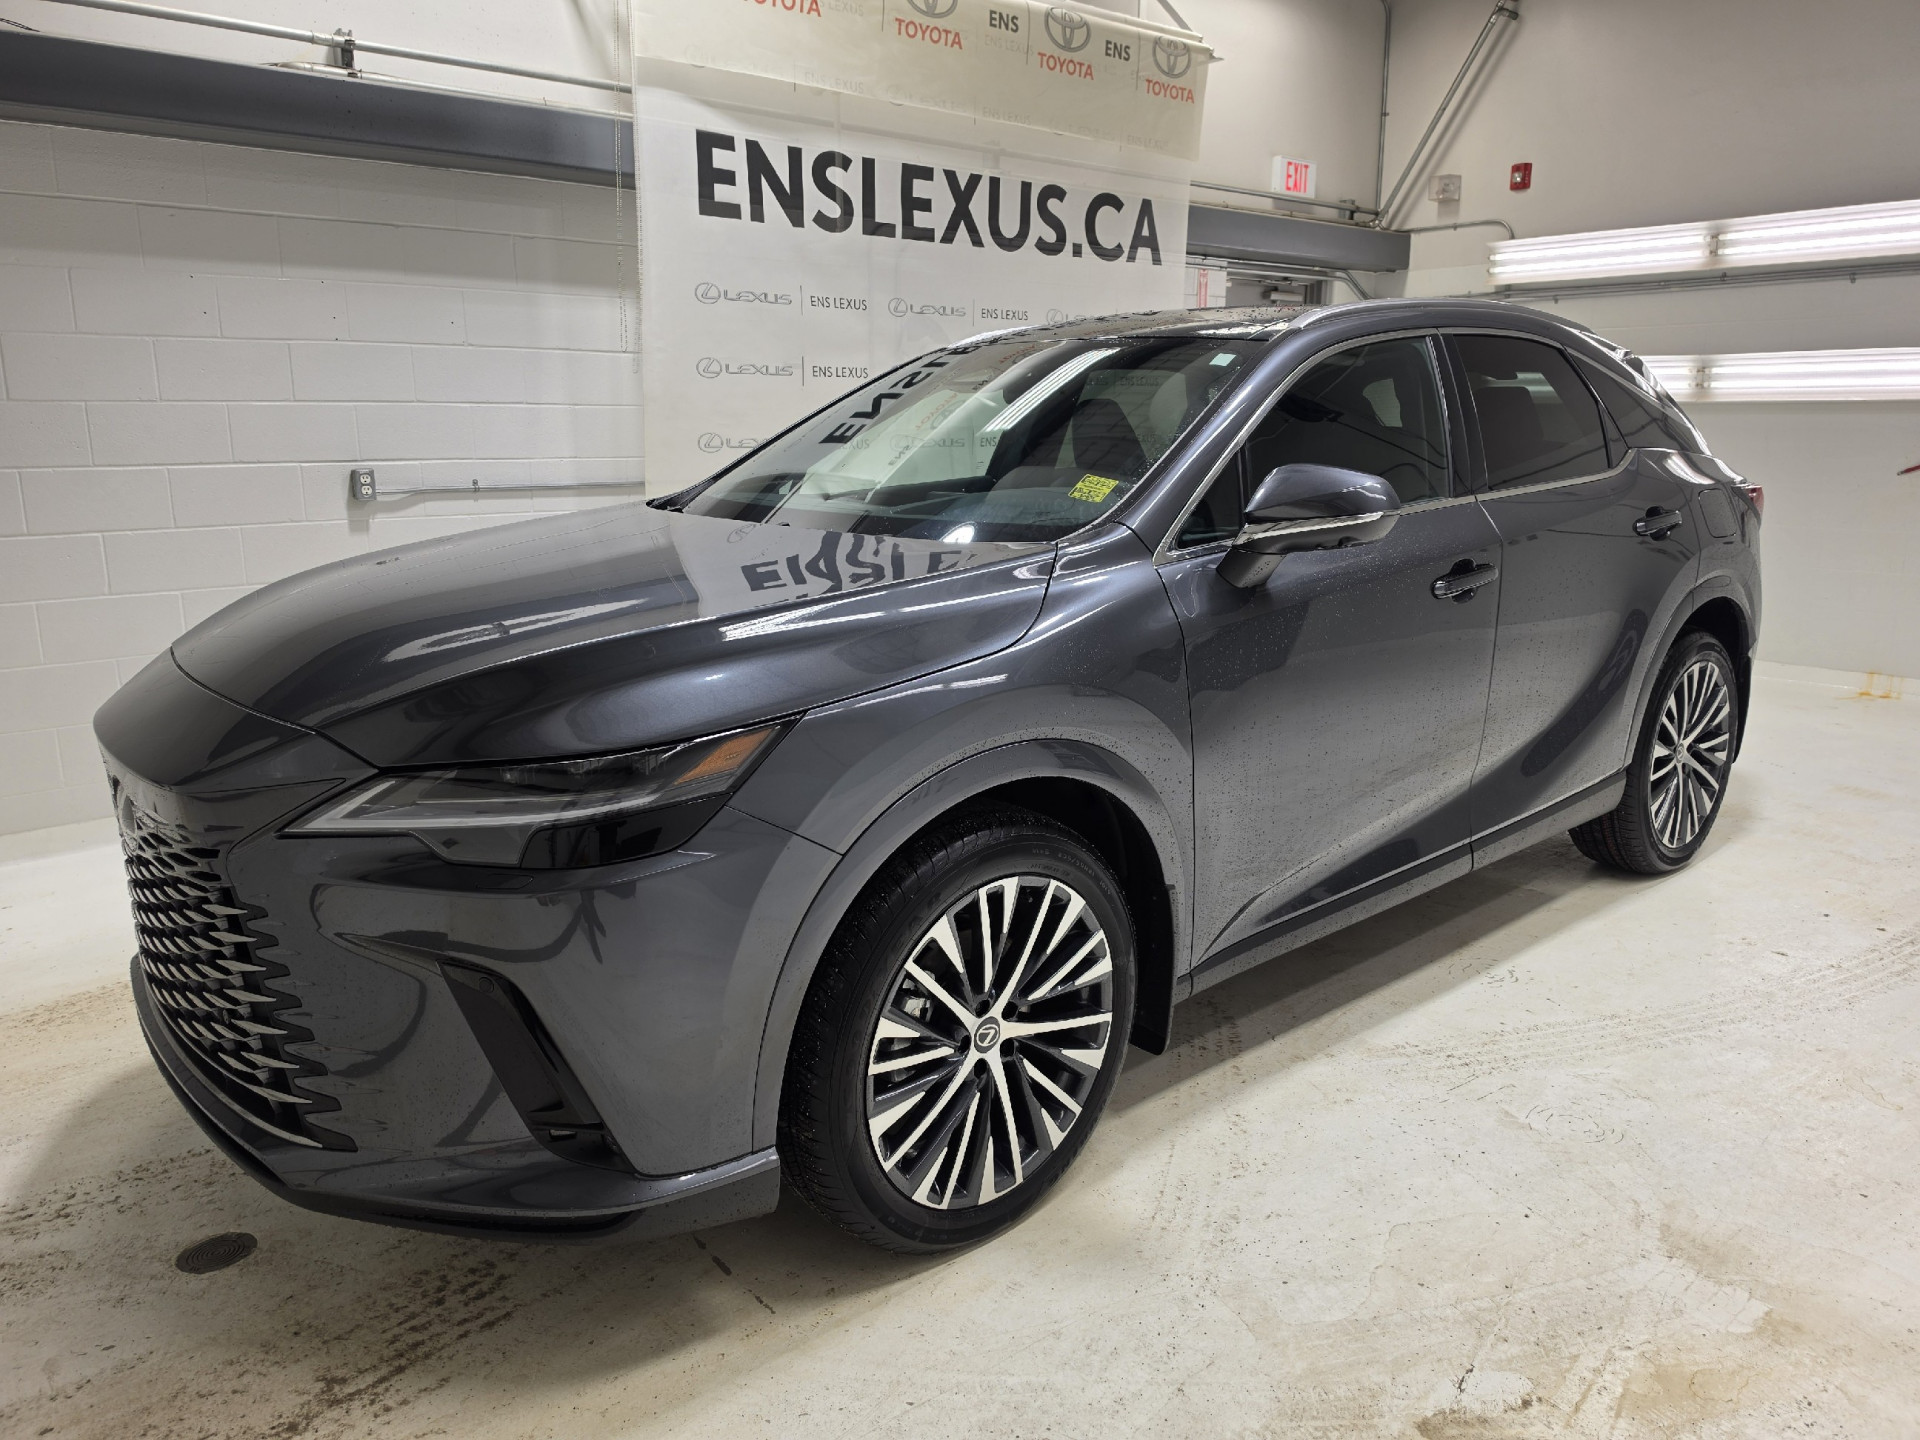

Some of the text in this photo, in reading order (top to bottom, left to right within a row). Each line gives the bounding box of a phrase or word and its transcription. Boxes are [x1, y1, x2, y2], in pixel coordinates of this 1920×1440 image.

[895, 17, 963, 50] TOYOTA
[989, 9, 1019, 34] ENS
[1104, 39, 1131, 62] ENS
[1037, 52, 1094, 81] TOYOTA
[1145, 78, 1195, 104] TOYOTA
[1285, 161, 1310, 194] EXIT
[695, 128, 1162, 267] ENSLEXUS.CA
[723, 289, 868, 311] LEXUS ENS LEXUS
[910, 303, 1029, 321] LEXUS ENS LEXUS
[725, 363, 869, 379] LEXUS ENS LEXUS
